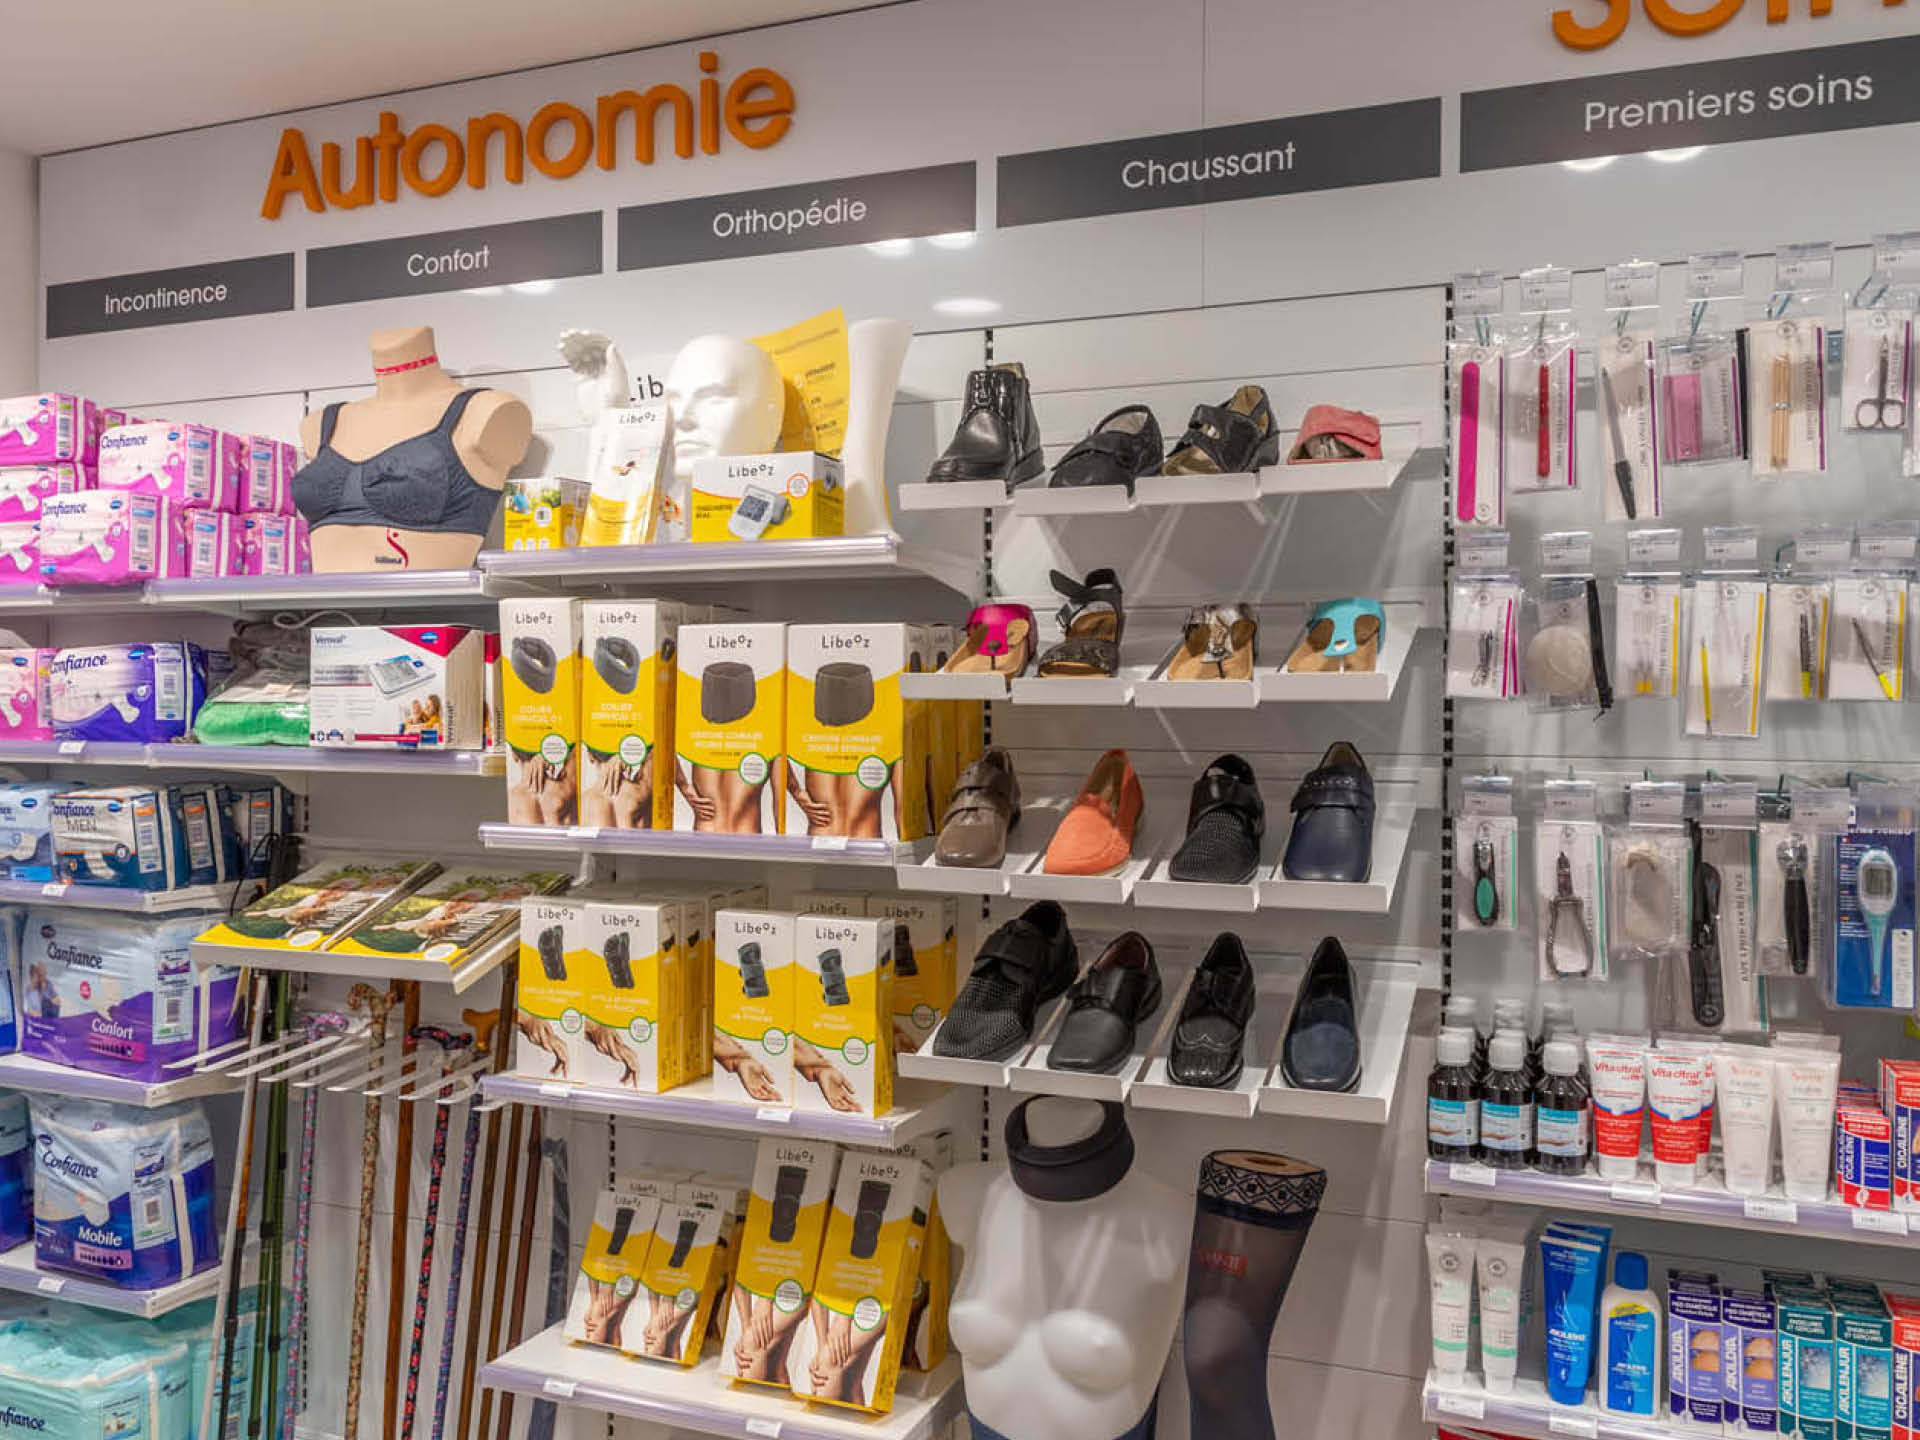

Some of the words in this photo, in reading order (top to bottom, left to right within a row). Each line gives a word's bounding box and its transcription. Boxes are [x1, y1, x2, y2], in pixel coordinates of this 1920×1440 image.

[1584, 88, 1755, 132] Premiers
[1767, 72, 1874, 109] soins
[259, 51, 796, 221] Autonomie
[1121, 141, 1296, 188] Chaussant
[711, 196, 867, 242] Orthopédie
[405, 244, 490, 278] Confort
[103, 280, 228, 316] Incontinence
[101, 434, 148, 451] Confiance
[67, 818, 96, 831] MEN
[47, 942, 103, 969] Confiance
[91, 1018, 134, 1039] Confort
[42, 1150, 98, 1179] Confiance
[78, 1225, 123, 1247] Mobile
[1672, 1328, 1683, 1384] AKILDIA
[1725, 1336, 1737, 1392] AKILDIA
[1781, 1339, 1792, 1407] AKILENJUR
[1838, 1347, 1850, 1415] AKILENJUR
